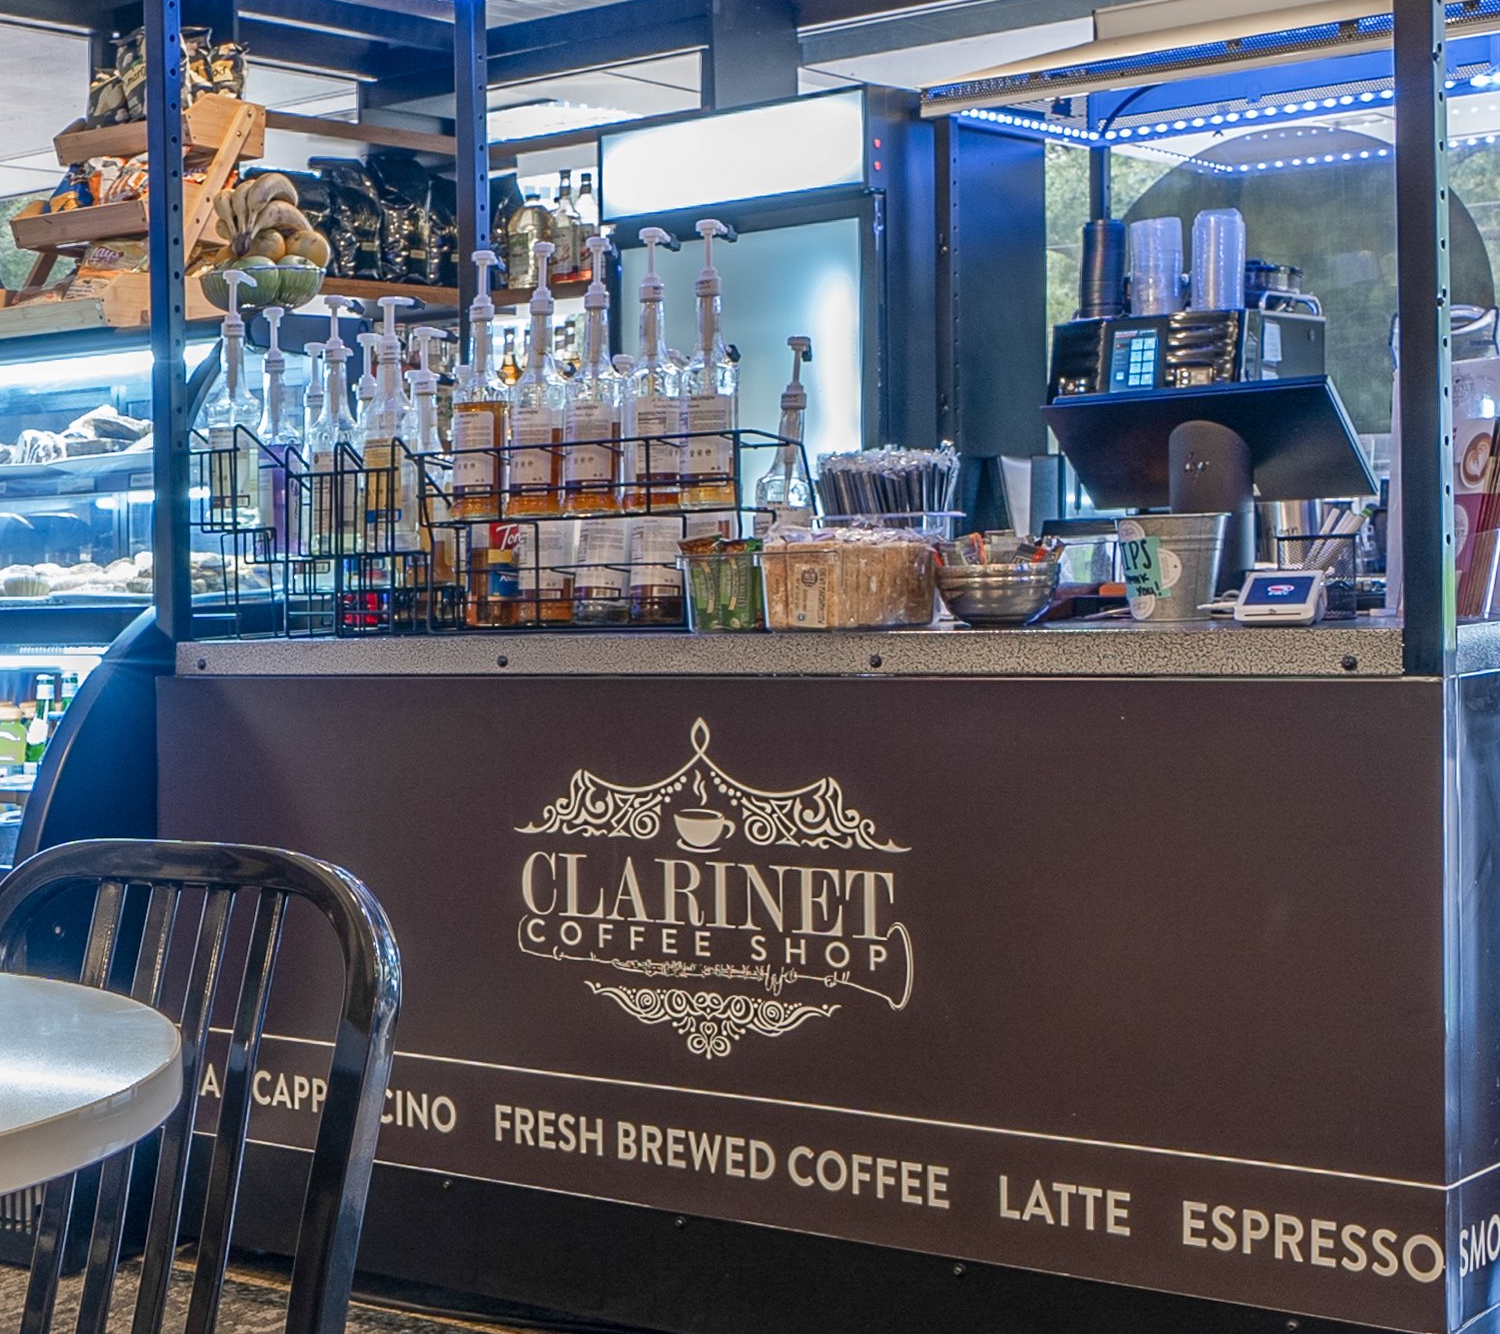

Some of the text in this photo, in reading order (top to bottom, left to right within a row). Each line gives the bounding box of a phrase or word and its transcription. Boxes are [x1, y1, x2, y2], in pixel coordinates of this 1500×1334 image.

[1121, 540, 1151, 571] IPS
[521, 851, 894, 940] CLARINET
[527, 919, 888, 970] COFFEE SHOP
[252, 1070, 457, 1133] CAPPCINO
[495, 1104, 950, 1208] FRESH BREWED COFFEE
[999, 1175, 1131, 1236] LATTE
[1182, 1200, 1445, 1283] ESPRESSO
